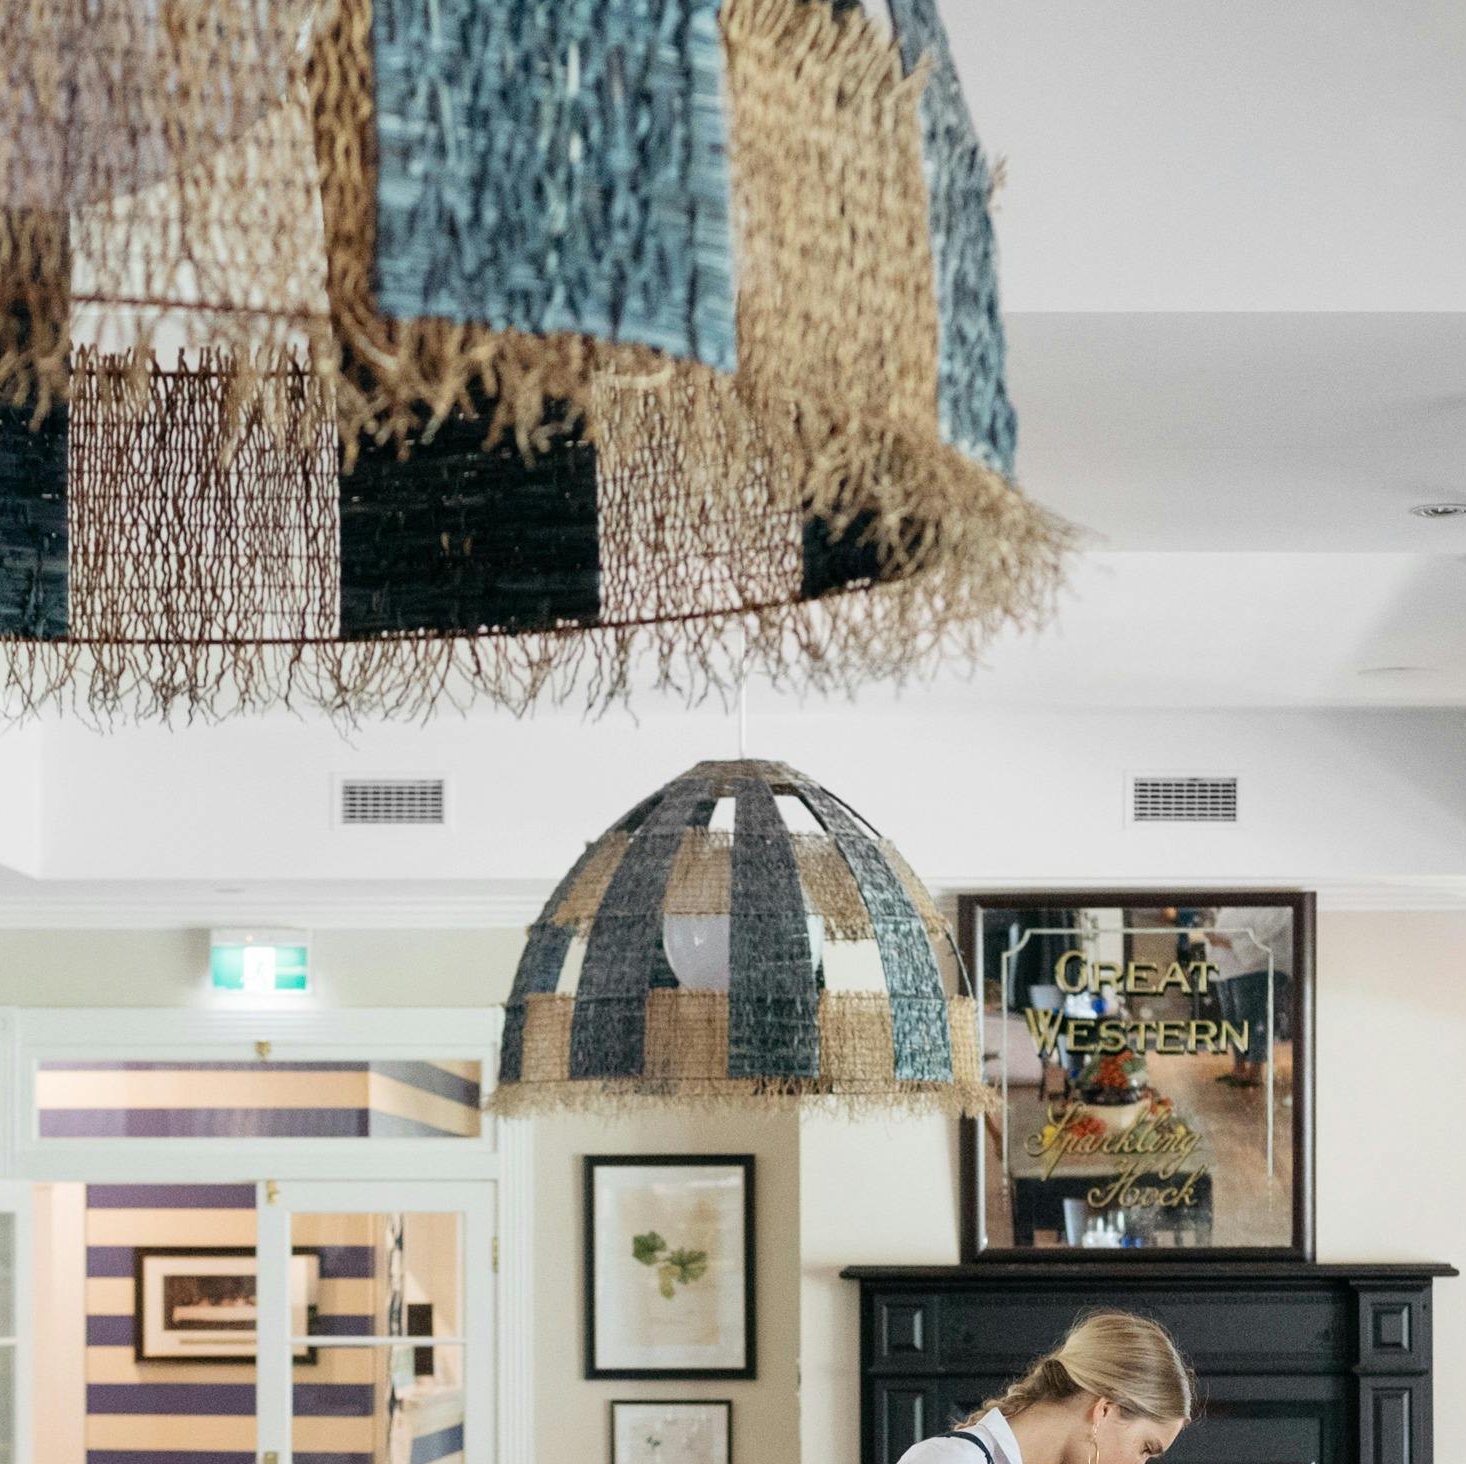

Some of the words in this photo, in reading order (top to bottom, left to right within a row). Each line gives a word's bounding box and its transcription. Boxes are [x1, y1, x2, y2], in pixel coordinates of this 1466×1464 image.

[1053, 951, 1220, 996] GREAT
[1025, 1007, 1250, 1056] WESTERN
[1024, 1103, 1206, 1182] Sparkling
[1086, 1158, 1209, 1210] Hock
